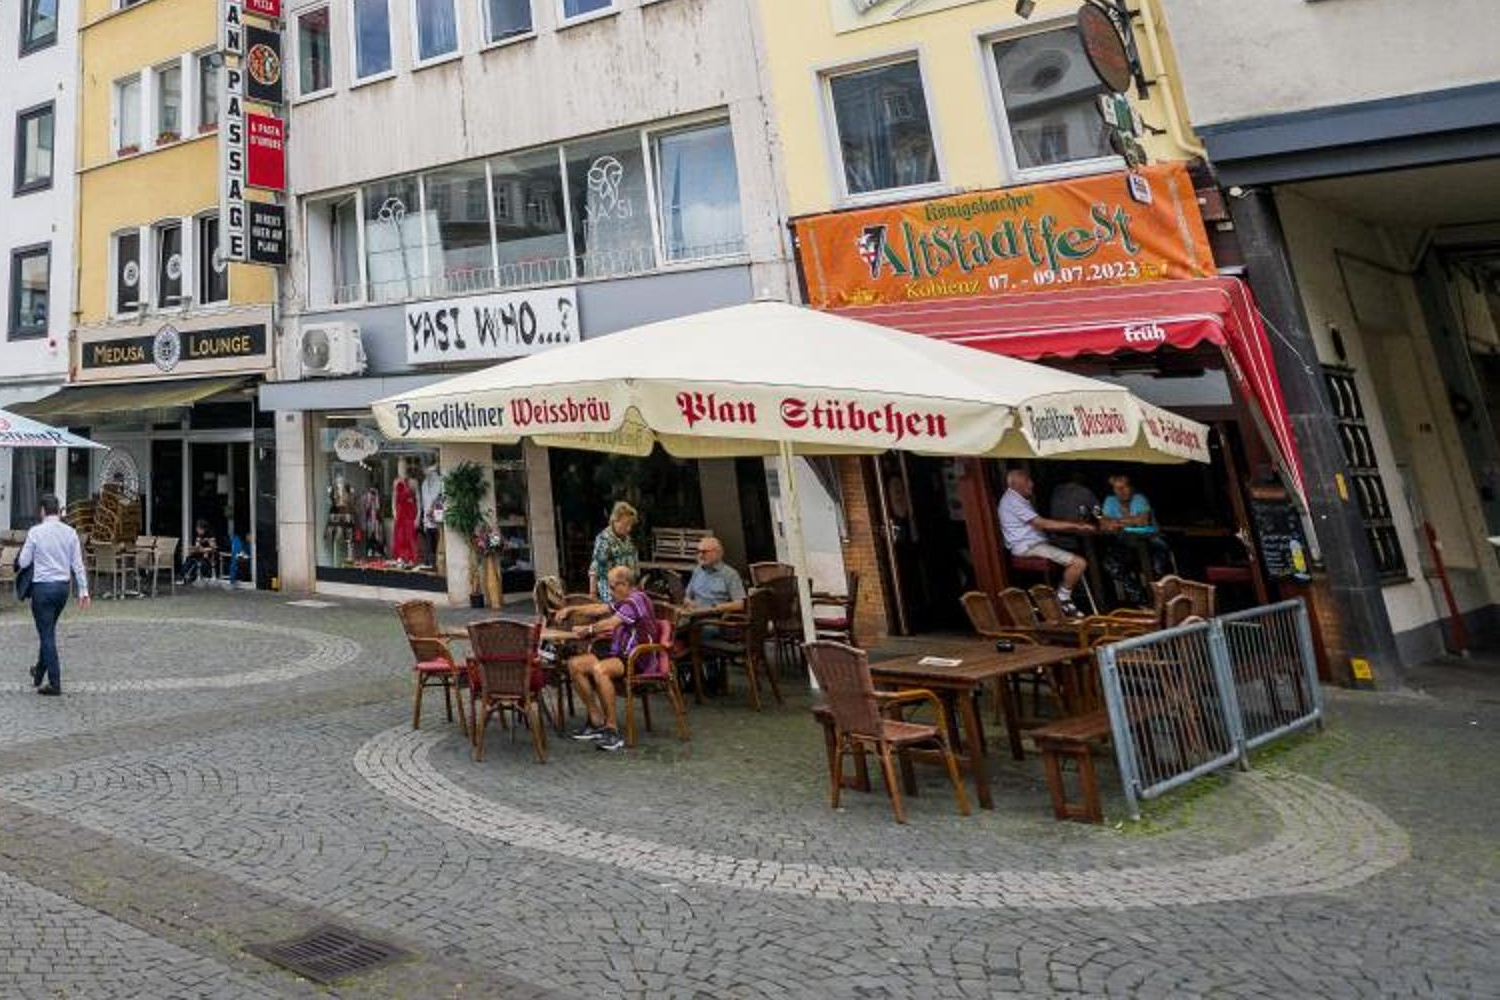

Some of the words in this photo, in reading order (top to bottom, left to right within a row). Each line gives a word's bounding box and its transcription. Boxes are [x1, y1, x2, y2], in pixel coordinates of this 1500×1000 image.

[227, 70, 243, 257] PASSAGE
[905, 279, 981, 300] Koblenz
[988, 273, 1018, 291] 07.
[1033, 261, 1139, 286] 09.07.2023
[93, 343, 145, 364] MEDUSA
[189, 335, 251, 357] LOUNGE
[408, 307, 467, 353] YASI
[395, 403, 504, 436] Benediktiner
[510, 397, 611, 427] Weissbräu
[676, 391, 757, 429] Plan
[780, 397, 948, 442] Stübchen
